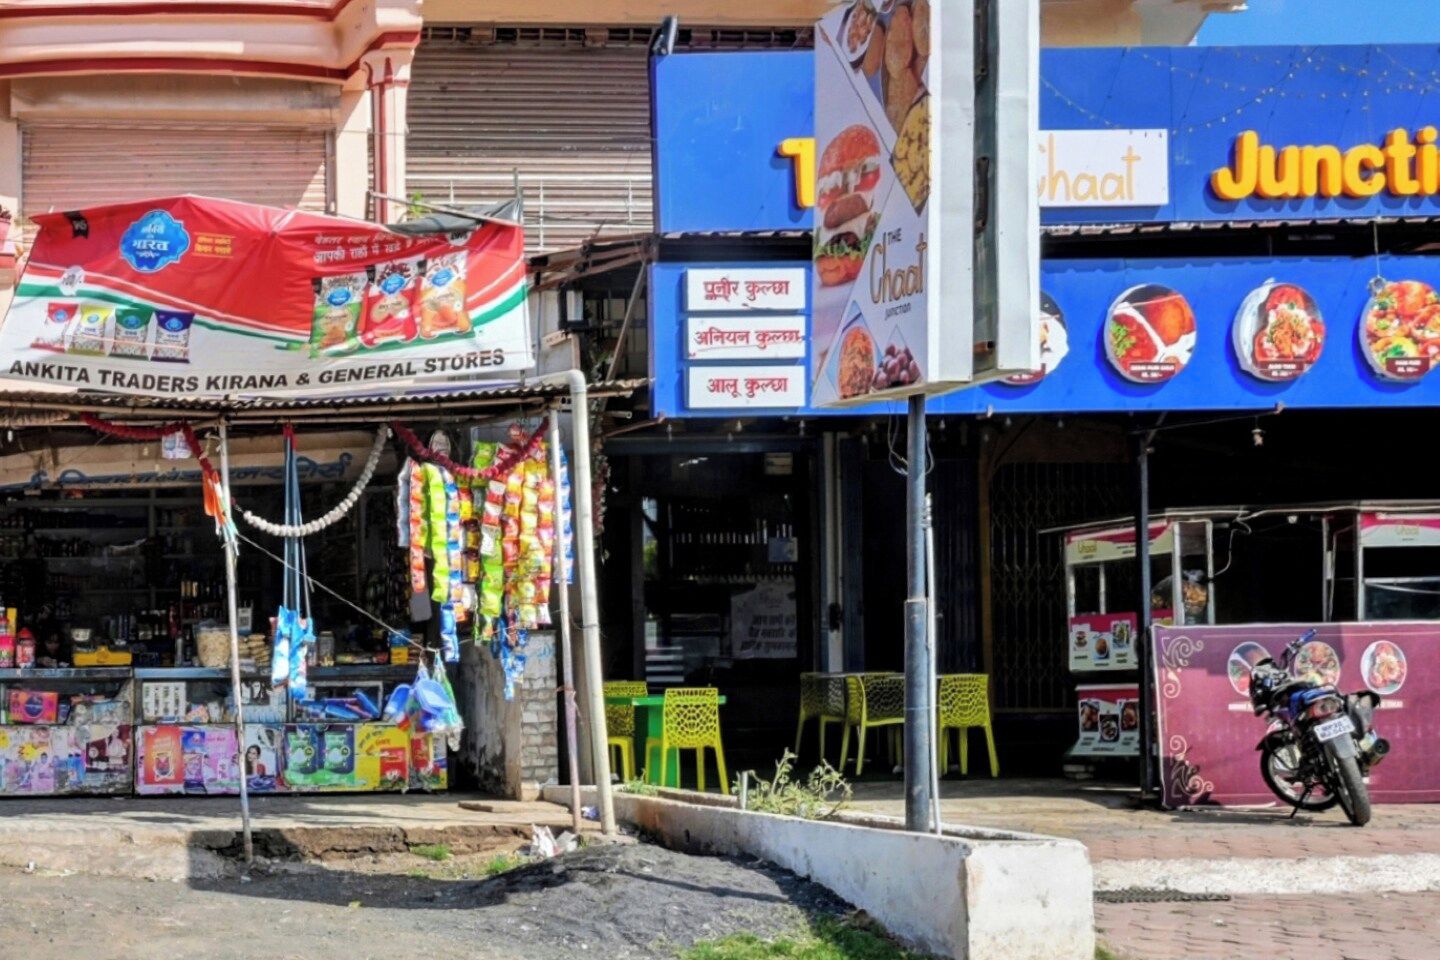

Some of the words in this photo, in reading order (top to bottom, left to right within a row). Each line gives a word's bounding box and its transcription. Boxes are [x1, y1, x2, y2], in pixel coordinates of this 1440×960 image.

[1039, 132, 1142, 202] haat
[1211, 125, 1440, 201] Juncti
[888, 228, 901, 245] THE
[870, 232, 928, 304] Chaat
[745, 280, 790, 301] कुल्छा
[695, 326, 750, 345] अनियन
[10, 360, 90, 383] ANKITA
[98, 369, 198, 392] TRADERS
[206, 374, 288, 390] KIRANA
[295, 373, 310, 385] &
[318, 361, 417, 384] GENERAL
[423, 348, 505, 372] STORES
[707, 377, 741, 398] आलू
[745, 377, 789, 398] कुल्छा
